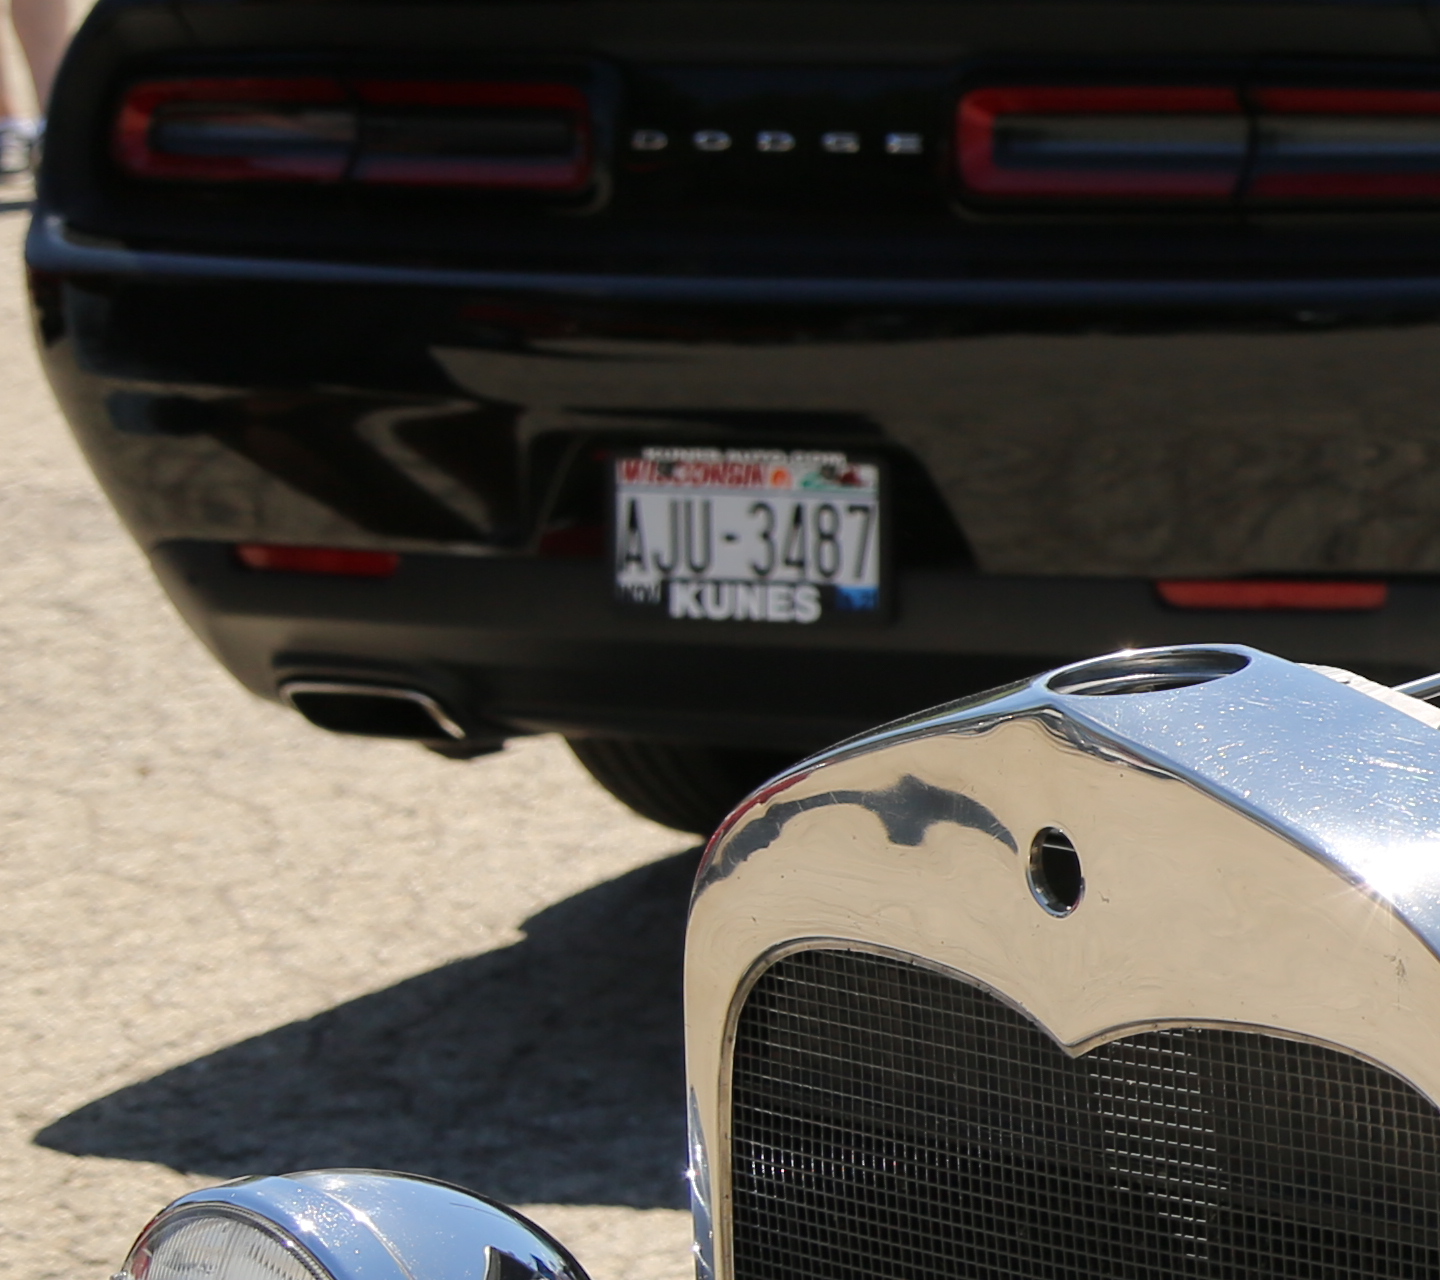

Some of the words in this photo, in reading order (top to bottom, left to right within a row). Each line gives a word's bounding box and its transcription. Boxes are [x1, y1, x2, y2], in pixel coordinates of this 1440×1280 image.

[630, 129, 923, 154] DODGE
[617, 496, 874, 579] AJU-3487
[668, 581, 822, 622] KUNES
